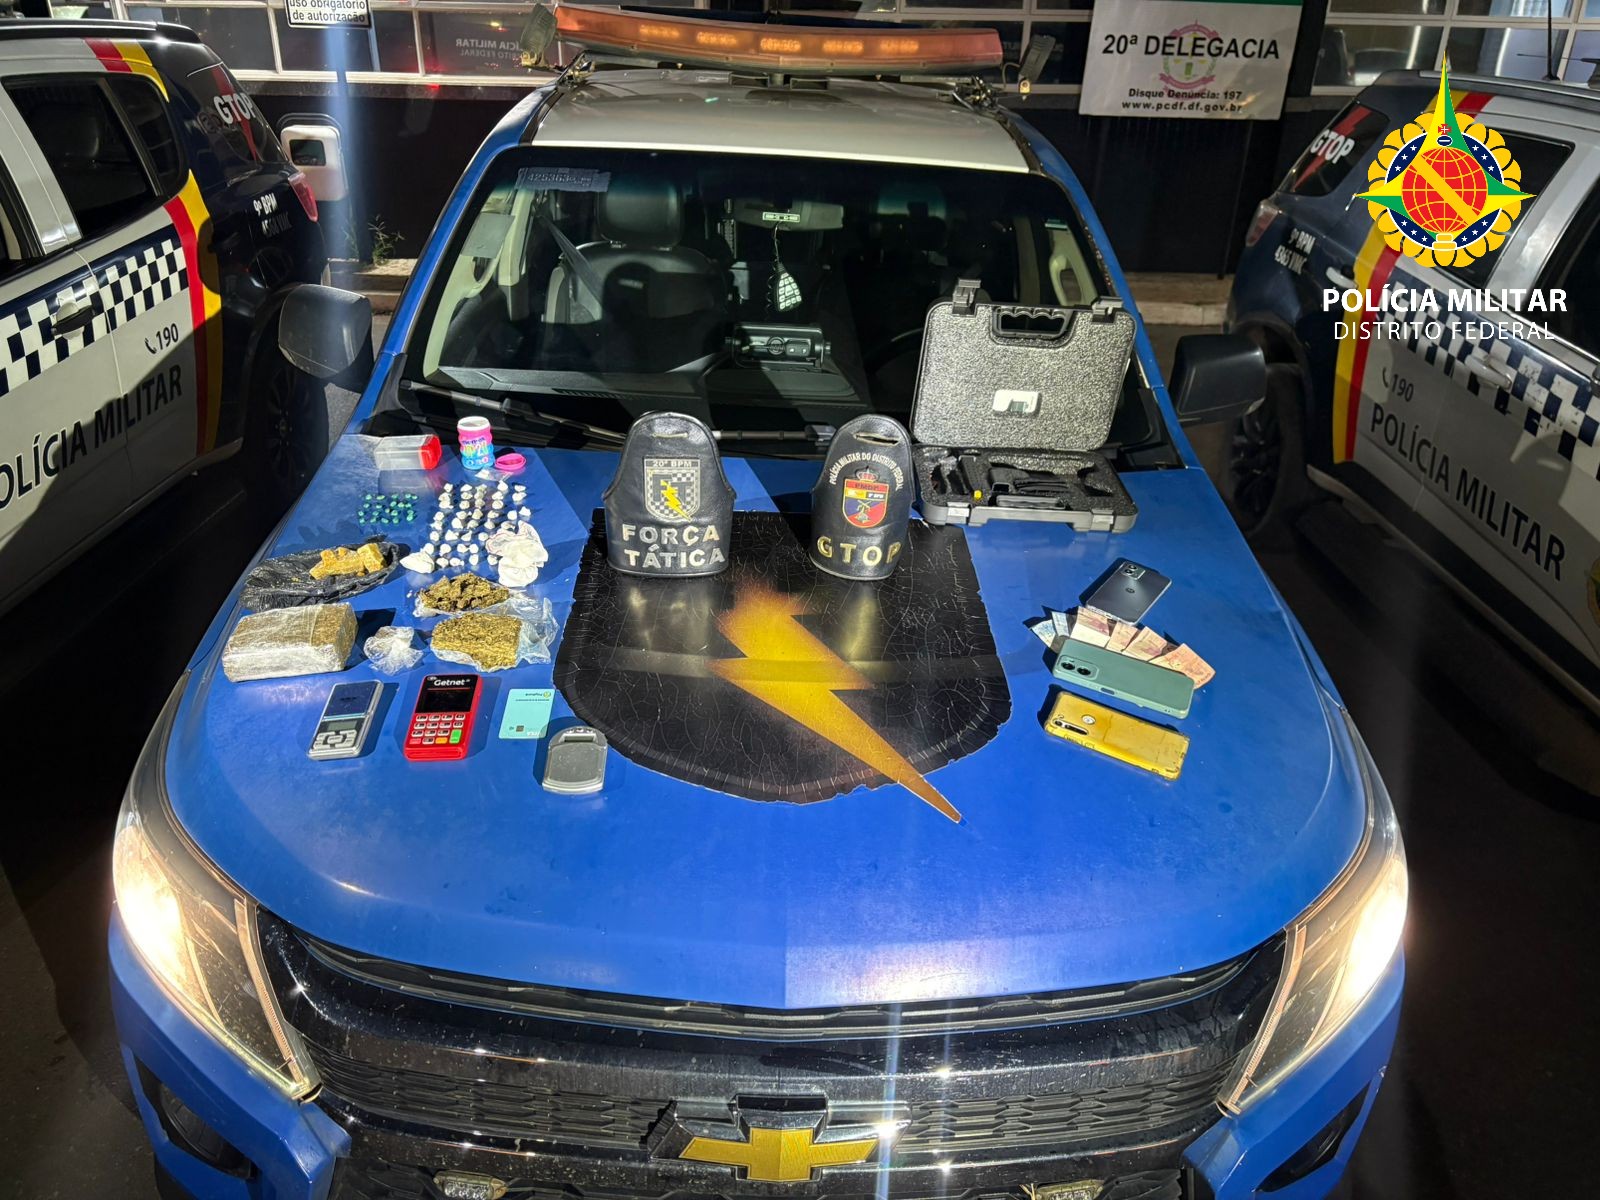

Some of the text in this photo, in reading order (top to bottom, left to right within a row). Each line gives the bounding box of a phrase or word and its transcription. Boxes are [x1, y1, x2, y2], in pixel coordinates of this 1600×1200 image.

[293, 10, 304, 20] de
[1144, 35, 1280, 59] DELEGACIA
[1121, 101, 1242, 113] www.pcdf.df.gov.br
[1128, 88, 1164, 99] Disque
[1223, 91, 1242, 100] 197
[213, 92, 256, 124] GTOP
[1310, 129, 1355, 164] GTOP
[155, 323, 180, 350] 190
[1391, 373, 1415, 403] 190
[0, 364, 183, 510] OLÍCIA MILITAR
[861, 452, 871, 460] DO
[1371, 402, 1566, 582] POLÍCIA MILITAR
[622, 523, 720, 546] FORÇA
[624, 543, 726, 568] TÁTICA
[817, 535, 902, 567] GTOP
